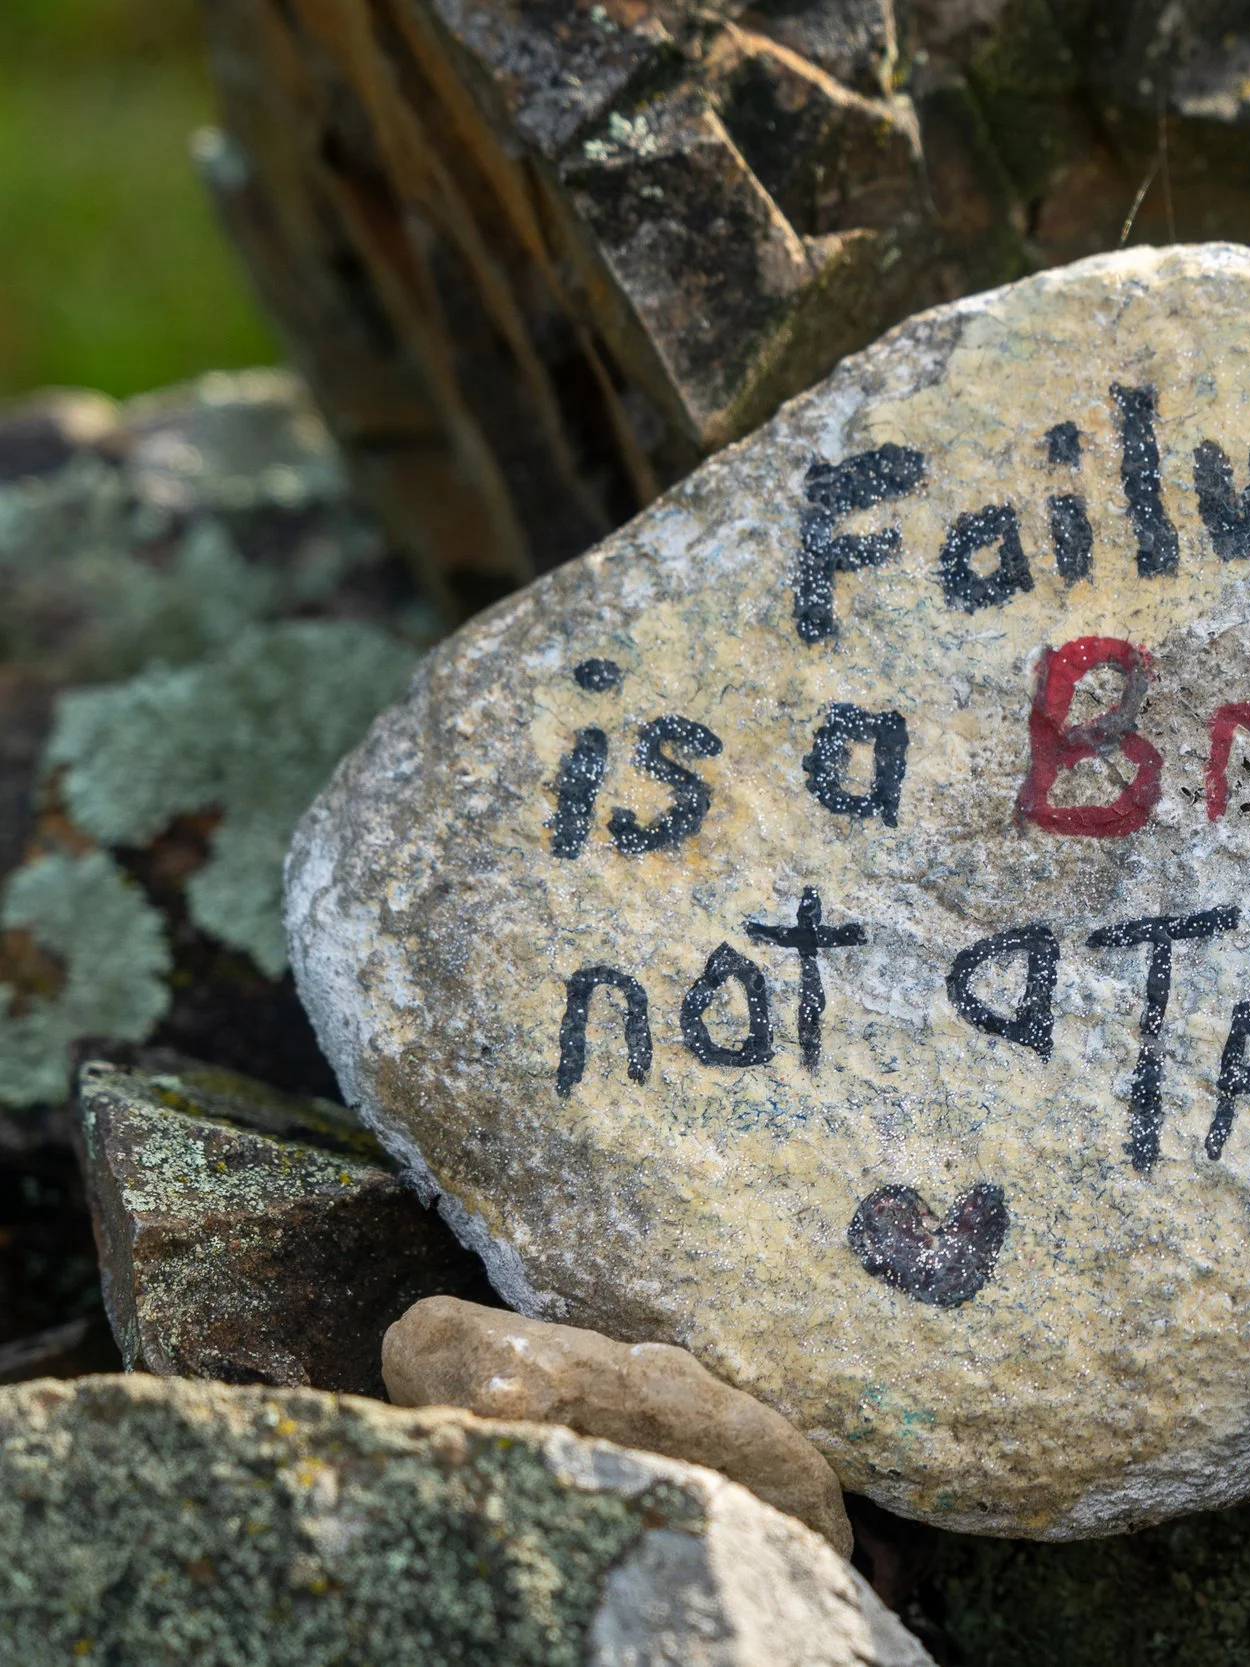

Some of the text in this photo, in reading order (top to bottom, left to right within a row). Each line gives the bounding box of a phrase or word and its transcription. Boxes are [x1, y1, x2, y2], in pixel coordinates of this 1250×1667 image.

[545, 658, 722, 858] is
[801, 704, 909, 827] a
[555, 886, 867, 1097] not
[945, 924, 1060, 1063] a
